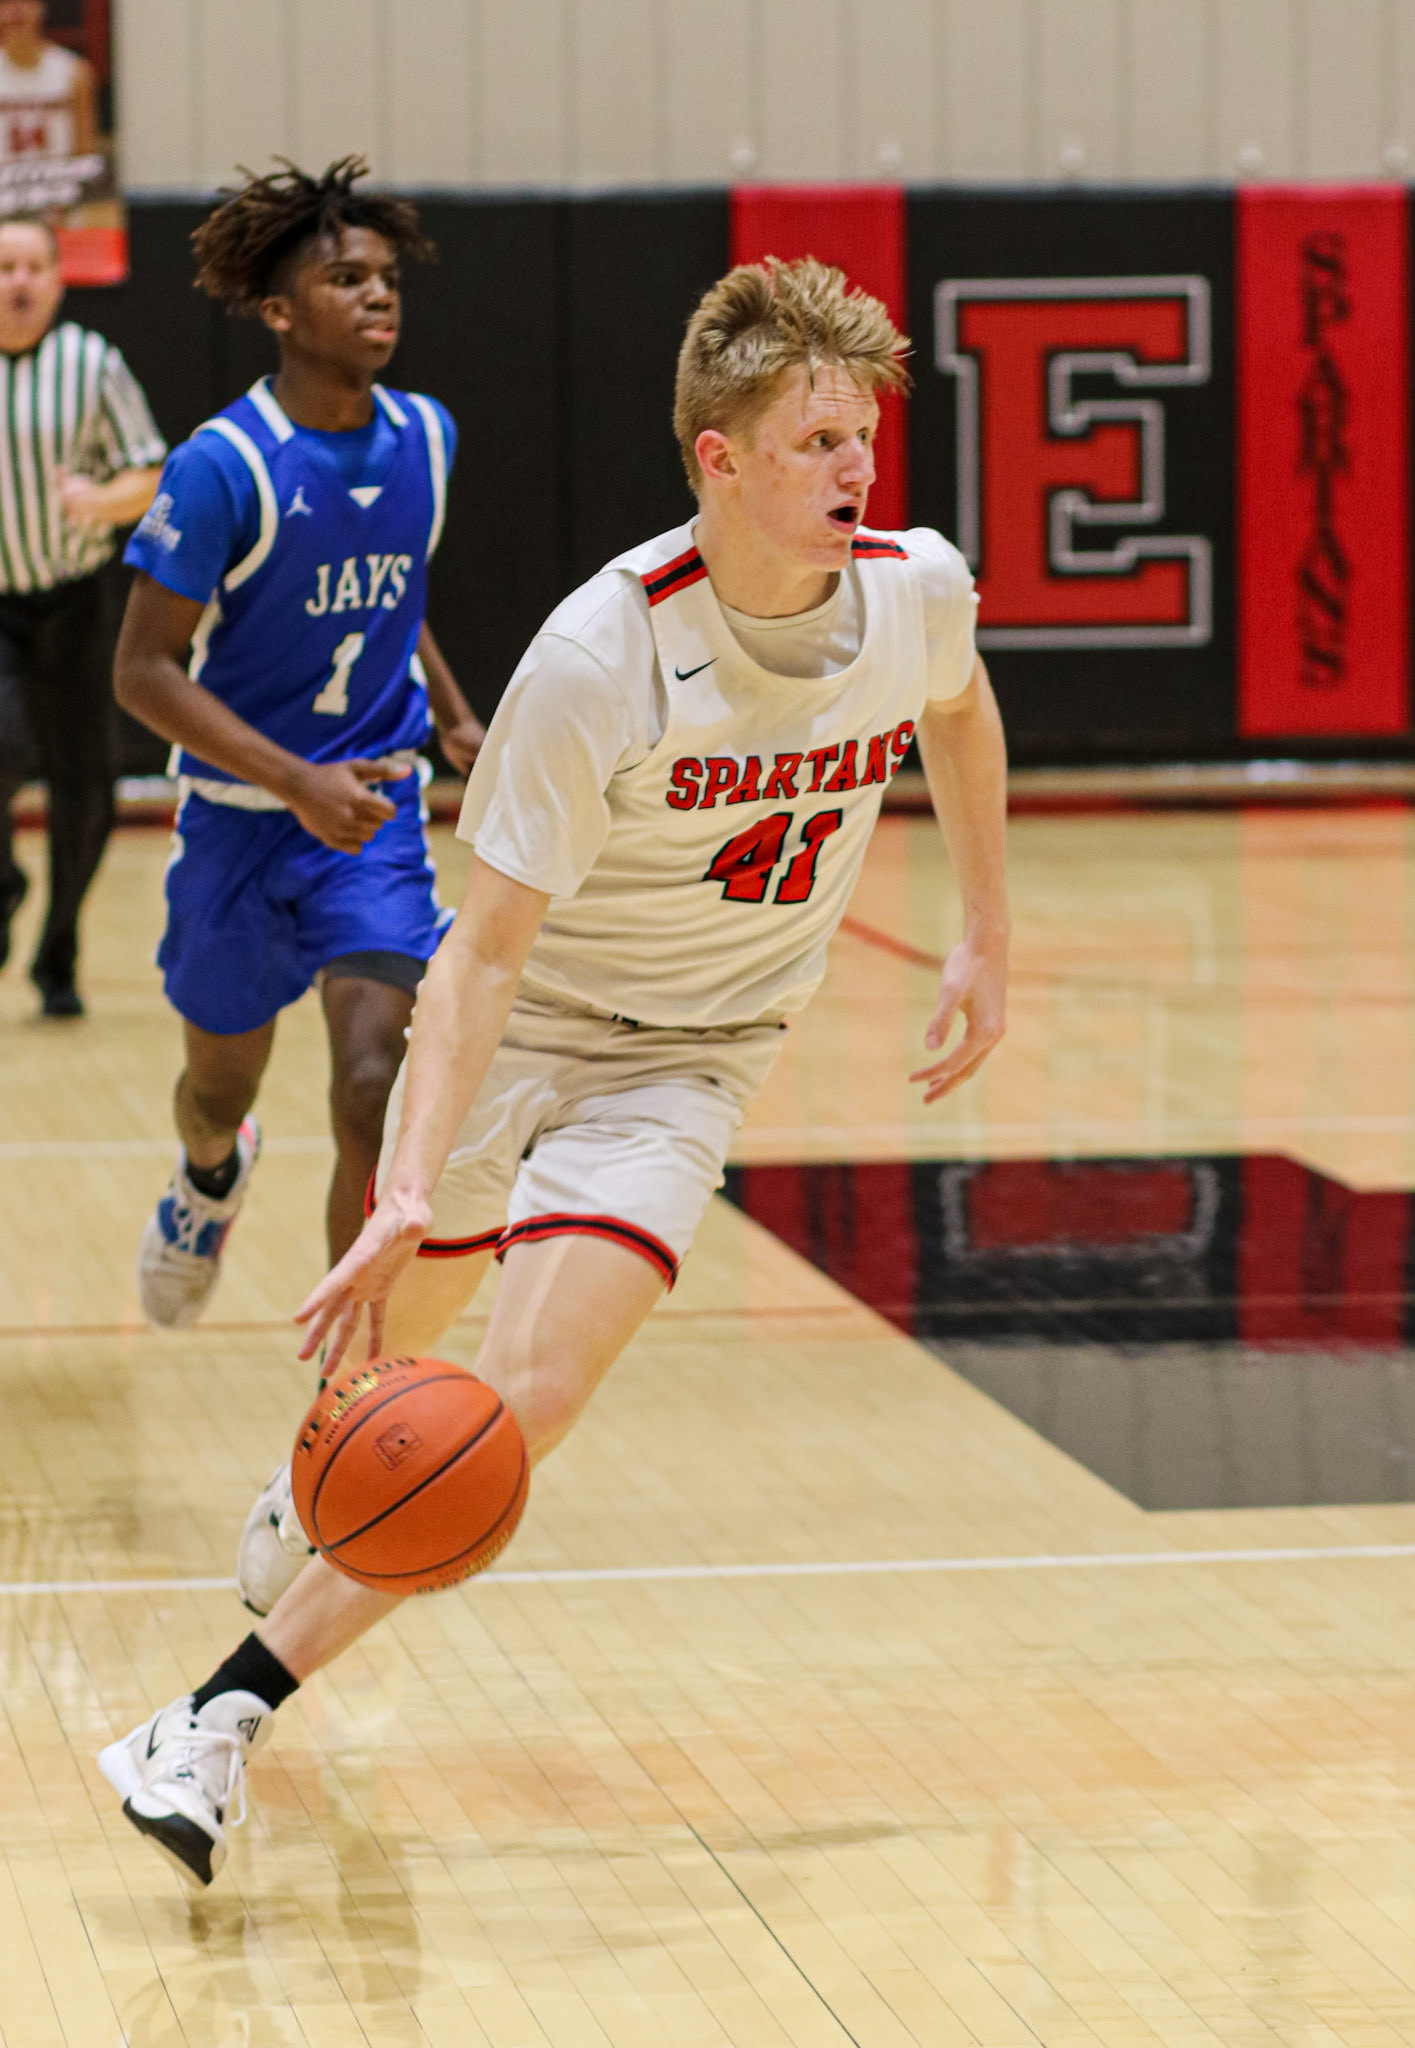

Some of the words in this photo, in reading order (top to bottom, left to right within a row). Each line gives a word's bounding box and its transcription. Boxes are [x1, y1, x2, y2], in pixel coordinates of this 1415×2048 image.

[934, 275, 1213, 650] E
[1298, 231, 1350, 690] SPARTANS
[305, 553, 412, 617] JAYS
[312, 632, 365, 716] 1
[666, 719, 915, 810] SPARTANS
[702, 808, 843, 904] 41
